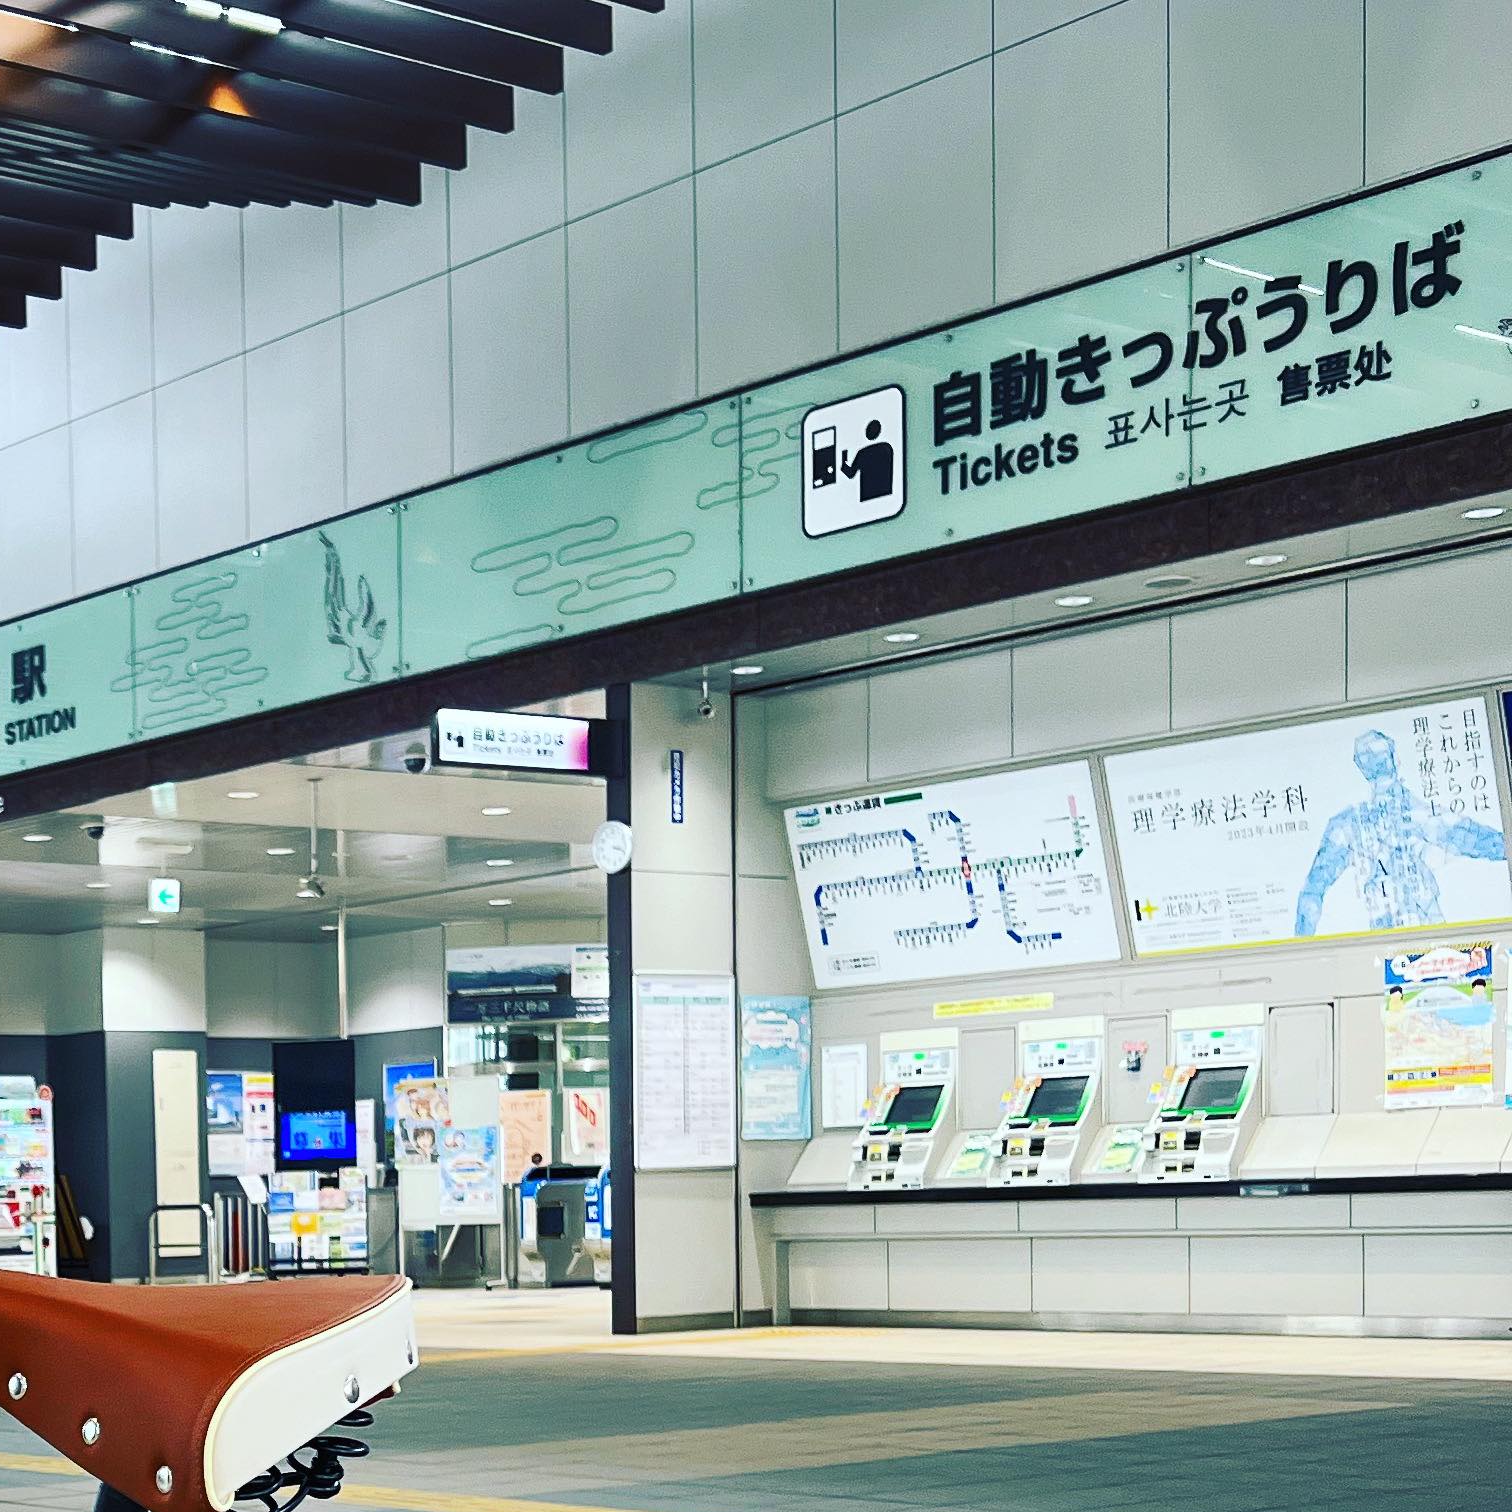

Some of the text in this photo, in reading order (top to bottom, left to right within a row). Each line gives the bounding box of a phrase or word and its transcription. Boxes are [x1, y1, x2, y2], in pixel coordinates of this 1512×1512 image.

[932, 219, 1465, 447] 自動きっぷうりば
[1276, 342, 1394, 407] 售票处
[933, 432, 1079, 495] Tickets
[4, 706, 77, 746] STATION
[1413, 717, 1442, 817] 理学療法士
[1440, 714, 1466, 813] これからの
[1463, 708, 1490, 812] 目指すのは
[1130, 785, 1308, 833] 理学療法学科
